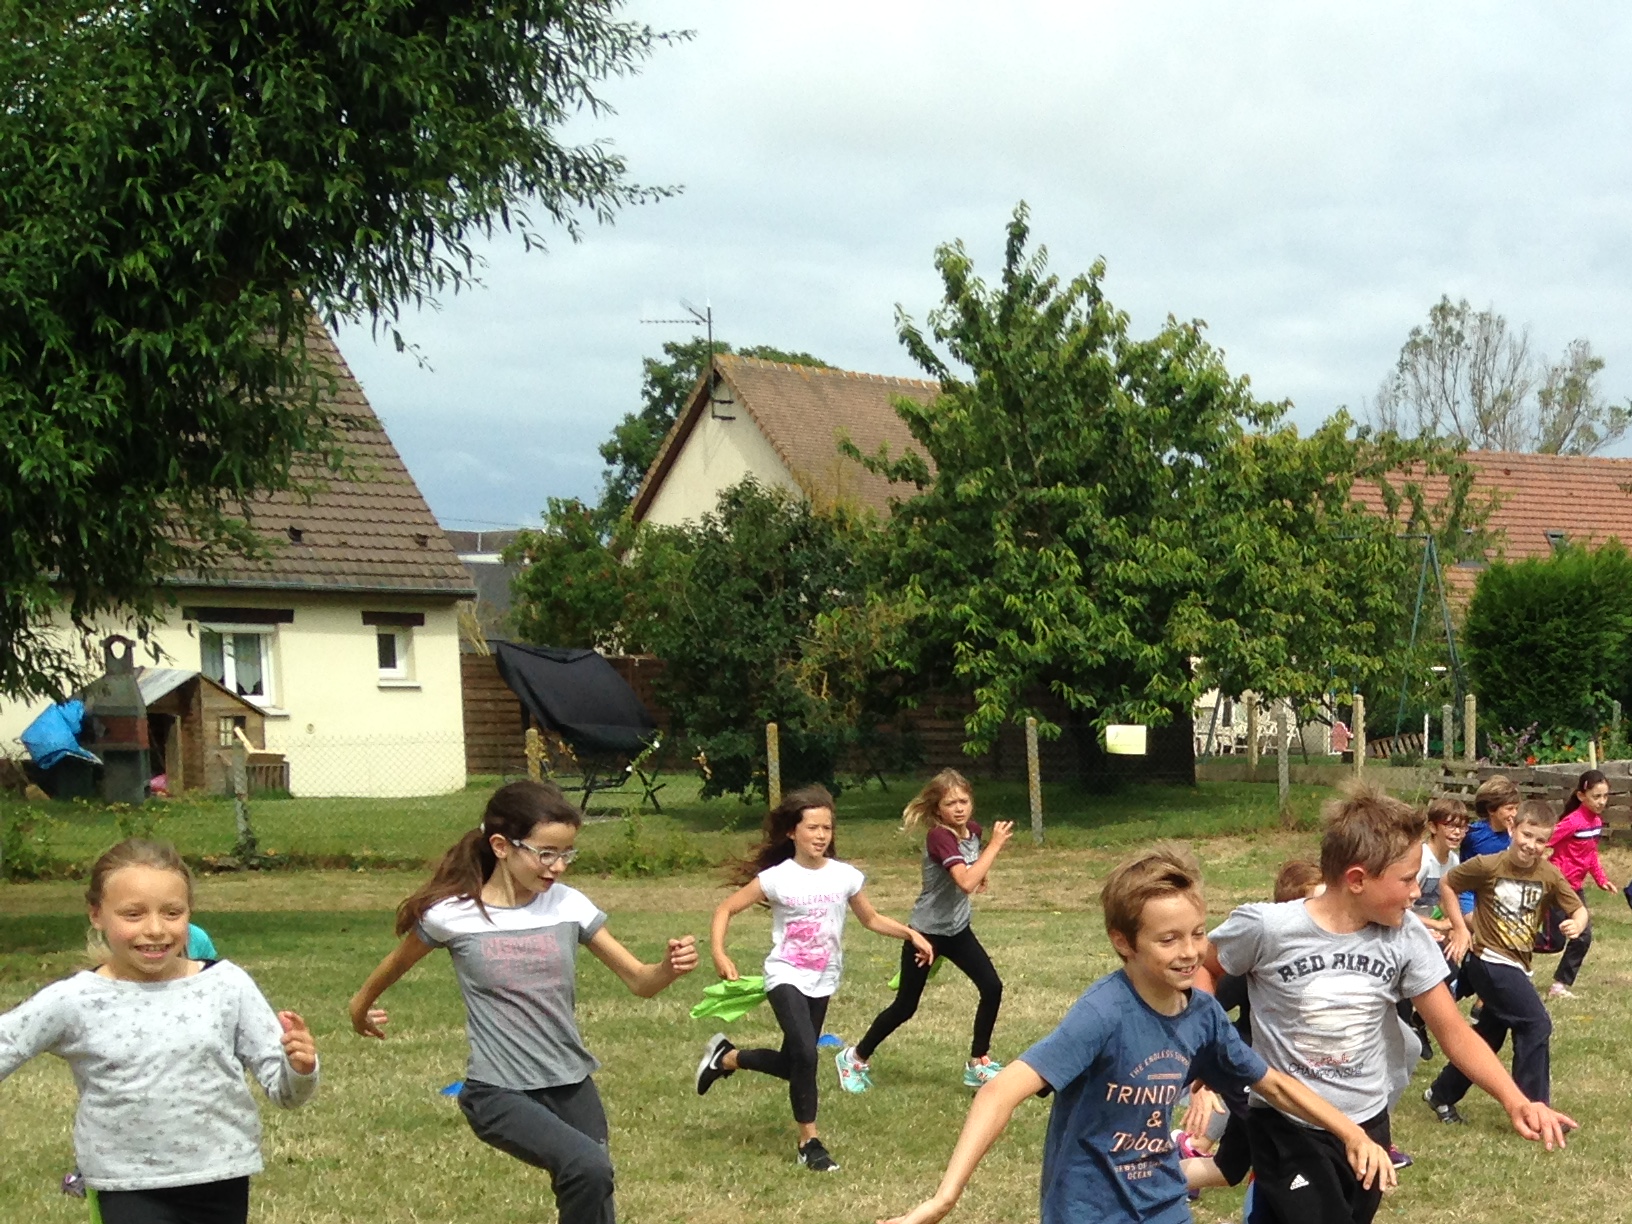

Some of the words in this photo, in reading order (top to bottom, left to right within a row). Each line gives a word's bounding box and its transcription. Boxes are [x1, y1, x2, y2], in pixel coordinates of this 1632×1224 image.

[1278, 955, 1325, 983] RED
[1331, 953, 1396, 984] BIRDS
[1129, 1063, 1145, 1078] THE
[1144, 1050, 1174, 1066] ENDLESS
[1106, 1082, 1177, 1105] TRINID
[1146, 1111, 1162, 1128] &
[1127, 1170, 1152, 1180] OCEAN
